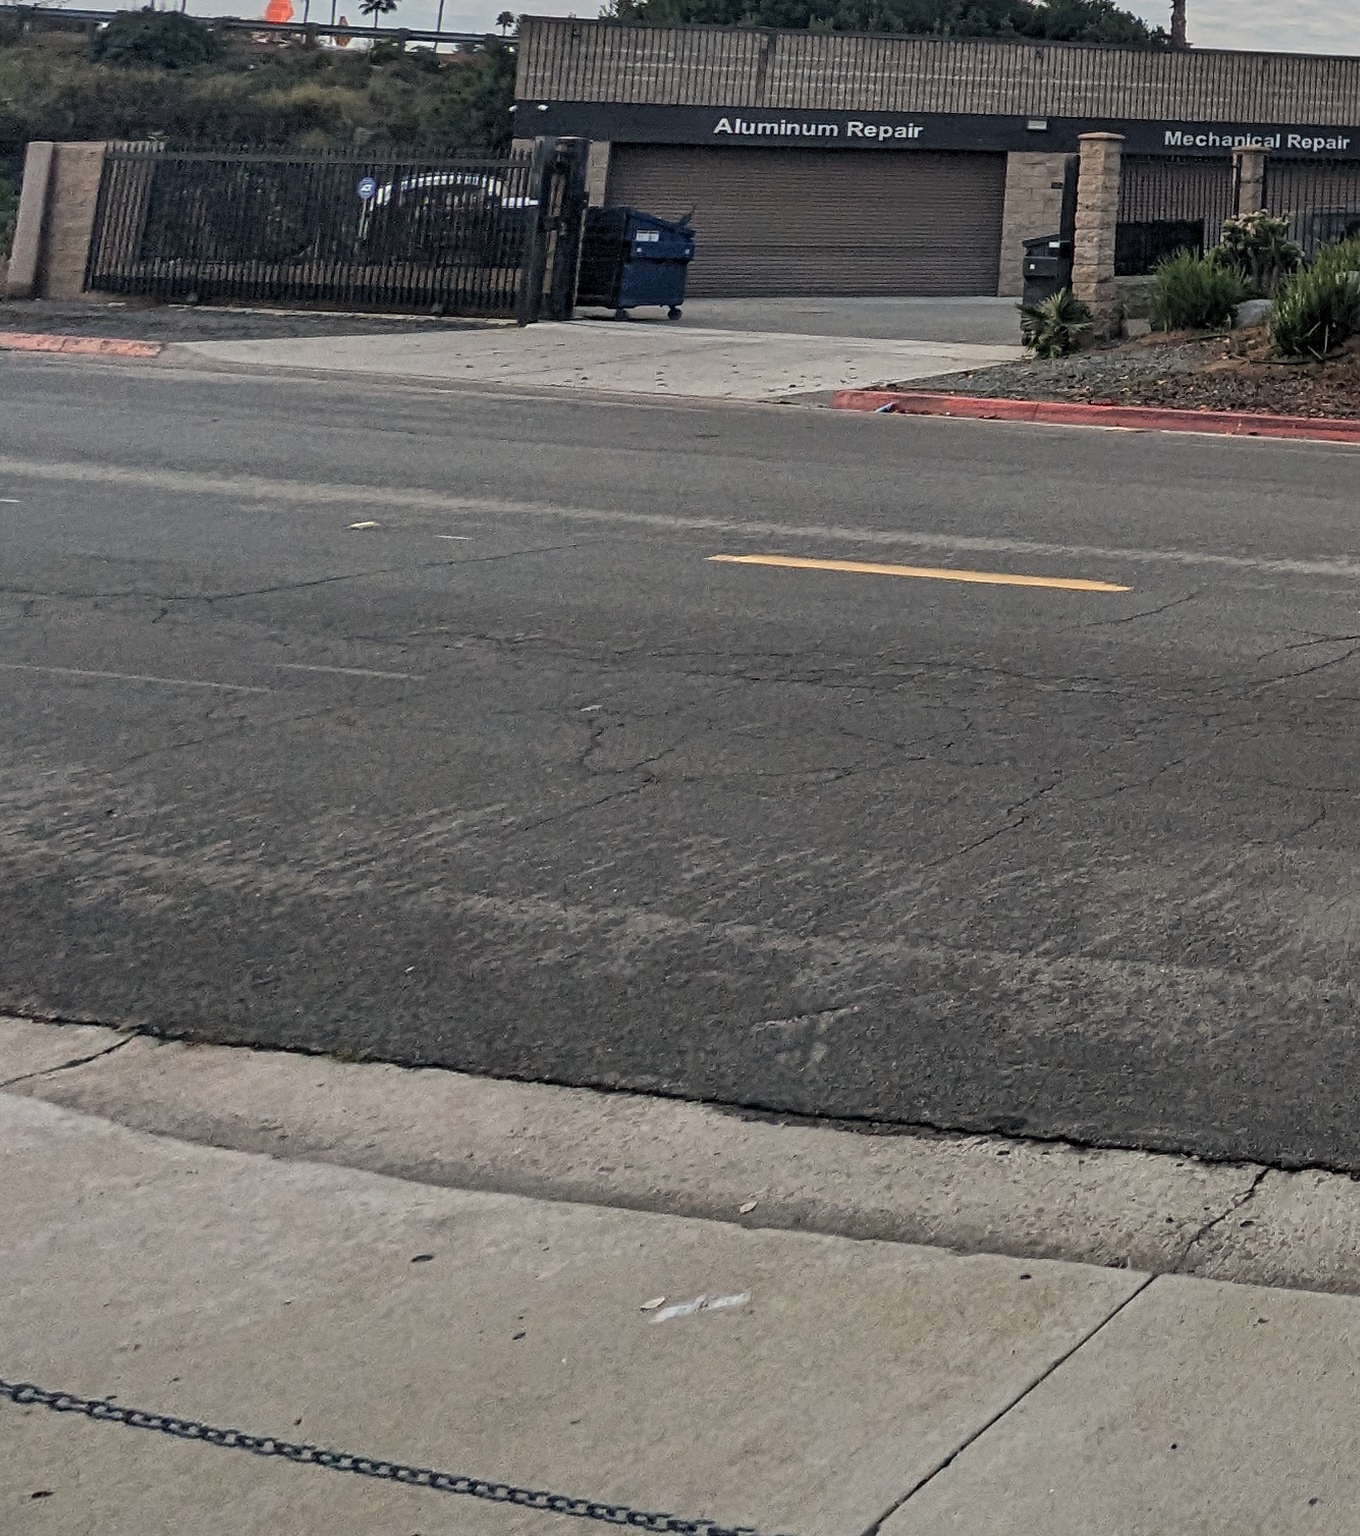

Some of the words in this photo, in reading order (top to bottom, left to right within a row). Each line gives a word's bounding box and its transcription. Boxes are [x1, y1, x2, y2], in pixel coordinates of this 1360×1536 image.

[713, 117, 839, 137] Aluminum
[847, 120, 924, 141] Repair
[1164, 130, 1281, 148] Mechanical
[1287, 133, 1350, 151] Repair
